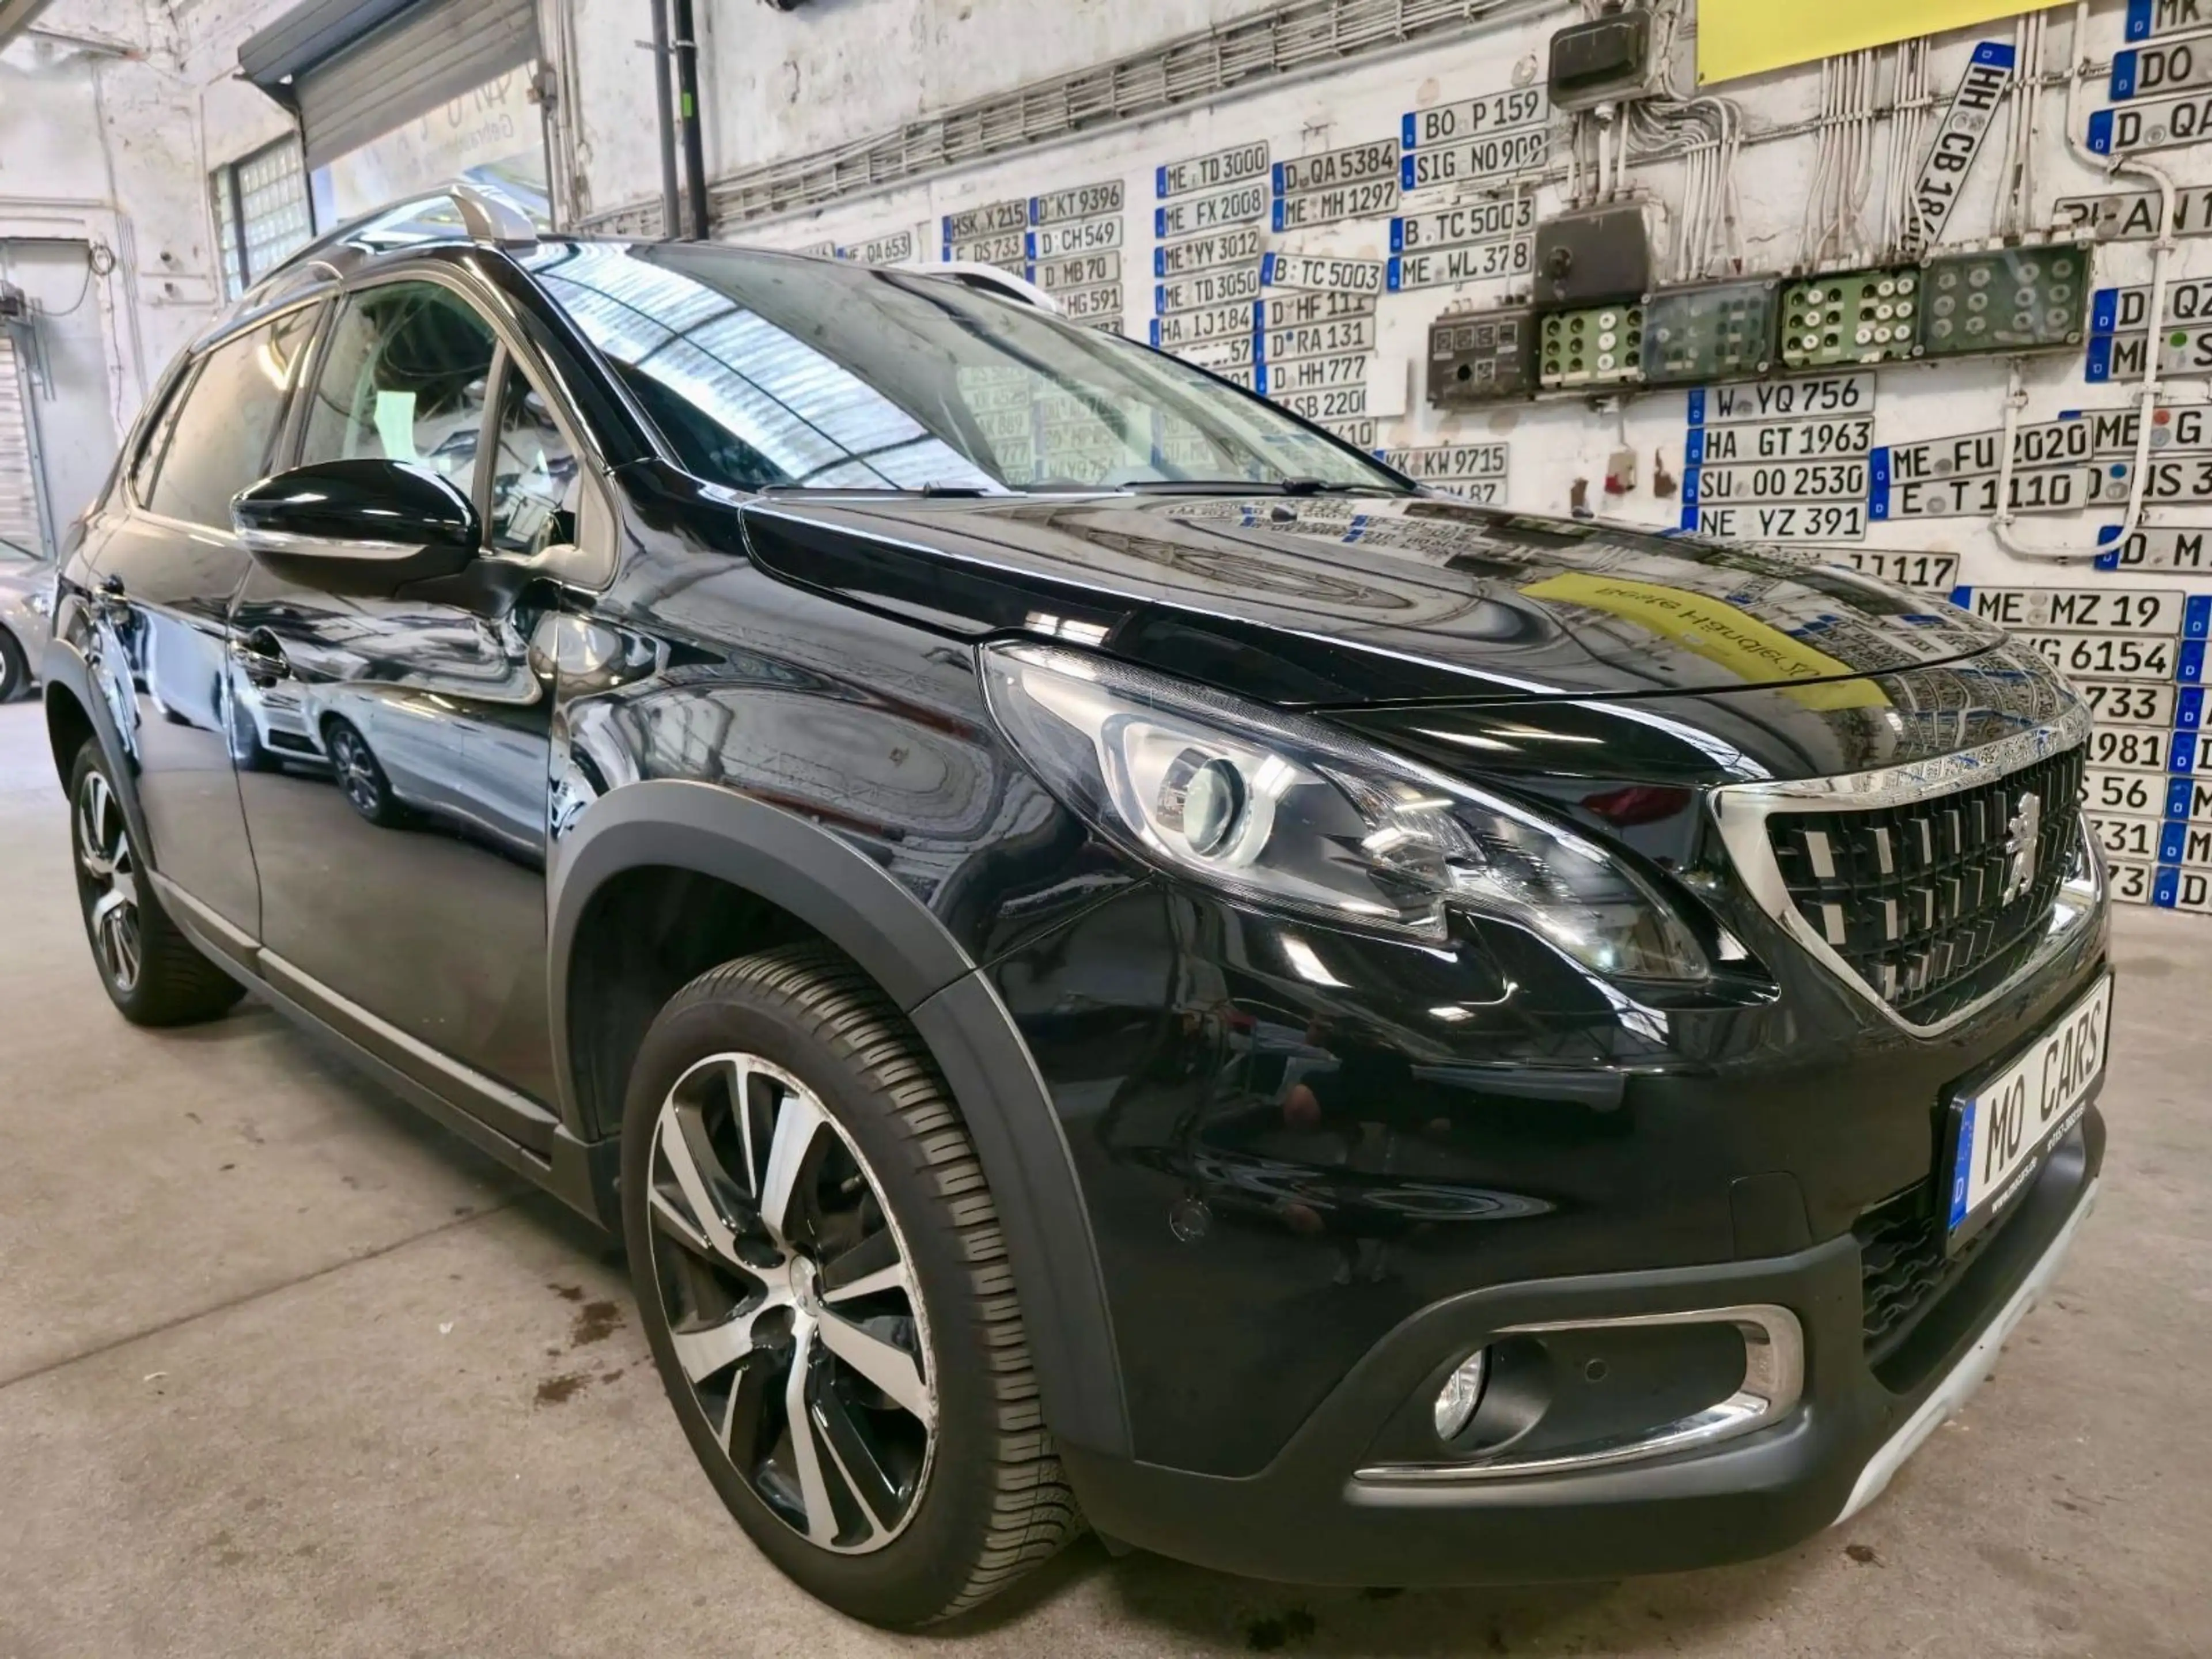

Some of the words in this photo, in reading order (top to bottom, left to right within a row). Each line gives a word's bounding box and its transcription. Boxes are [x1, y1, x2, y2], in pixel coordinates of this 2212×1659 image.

[2139, 45, 2192, 89] DO
[1959, 66, 2006, 111] HH
[1426, 109, 1455, 140] BO
[1472, 103, 1487, 130] P
[1494, 90, 1539, 126] 159
[2115, 112, 2141, 148] D
[1167, 167, 1186, 192] ME
[1199, 157, 1219, 181] TD
[1224, 146, 1264, 178] 3000
[1285, 165, 1297, 190] D
[1310, 156, 1336, 185] QA
[1341, 145, 1394, 179] 5384
[1417, 151, 1455, 183] SIG
[1933, 131, 1975, 173] CB
[1057, 193, 1074, 216] KT
[1166, 207, 1184, 231] ME
[1197, 199, 1216, 225] FX
[1221, 189, 1261, 219] 2008
[1286, 199, 1306, 226] ME
[1321, 191, 1344, 218] MH
[1349, 181, 1395, 214] 1297
[1062, 229, 1082, 251] CH
[1085, 222, 1114, 246] 549
[1406, 220, 1419, 245] B
[1436, 211, 1465, 240] TC
[1471, 200, 1532, 234] 5003
[1087, 257, 1105, 279] 70
[1165, 245, 1183, 271] ME
[1219, 231, 1257, 260] 3012
[1403, 257, 1431, 284] ME
[1448, 249, 1477, 278] WL
[1483, 243, 1527, 274] 378
[1165, 285, 1183, 308] ME
[1217, 270, 1256, 299] 3050
[1274, 259, 1287, 281] B
[1302, 260, 1324, 285] TC
[1329, 263, 1380, 289] 5003
[1161, 318, 1181, 342] HA
[1218, 306, 1249, 334] 184
[1272, 301, 1284, 325] D
[1297, 294, 1322, 321] HF
[2119, 291, 2145, 325] D
[1273, 335, 1285, 357] D
[1297, 329, 1321, 354] RA
[1327, 321, 1365, 349] 131
[1275, 367, 1286, 389] D
[1298, 361, 1324, 387] HH
[1329, 355, 1366, 382] 777
[1294, 395, 1319, 419] SB
[1718, 389, 1734, 417] W
[1757, 384, 1794, 414] YQ
[1802, 378, 1859, 412] 756
[1706, 431, 1737, 459] HA
[1759, 427, 1793, 456] GT
[1800, 422, 1870, 454] 1963
[2176, 411, 2202, 444] G
[1455, 447, 1505, 474] 9715
[1894, 446, 1931, 479] ME
[1955, 437, 1993, 472] FU
[1701, 471, 1732, 498] SU
[1794, 465, 1863, 495] 2530
[1903, 484, 1922, 513] E
[1950, 481, 1969, 511] T
[1701, 510, 1736, 536] NE
[1759, 509, 1796, 536] YZ
[1804, 507, 1861, 536] 391
[2120, 533, 2146, 564] D
[2173, 534, 2202, 566] M
[1978, 592, 2024, 623] ME
[2050, 594, 2101, 625] MZ
[2111, 596, 2160, 627] 19
[2031, 638, 2061, 667] G
[2071, 639, 2166, 674] 6154
[2085, 686, 2157, 720] 733
[2101, 776, 2147, 808] 56
[2181, 874, 2207, 906] D
[1983, 1074, 2024, 1184] MO
[2040, 999, 2101, 1122] CARS
